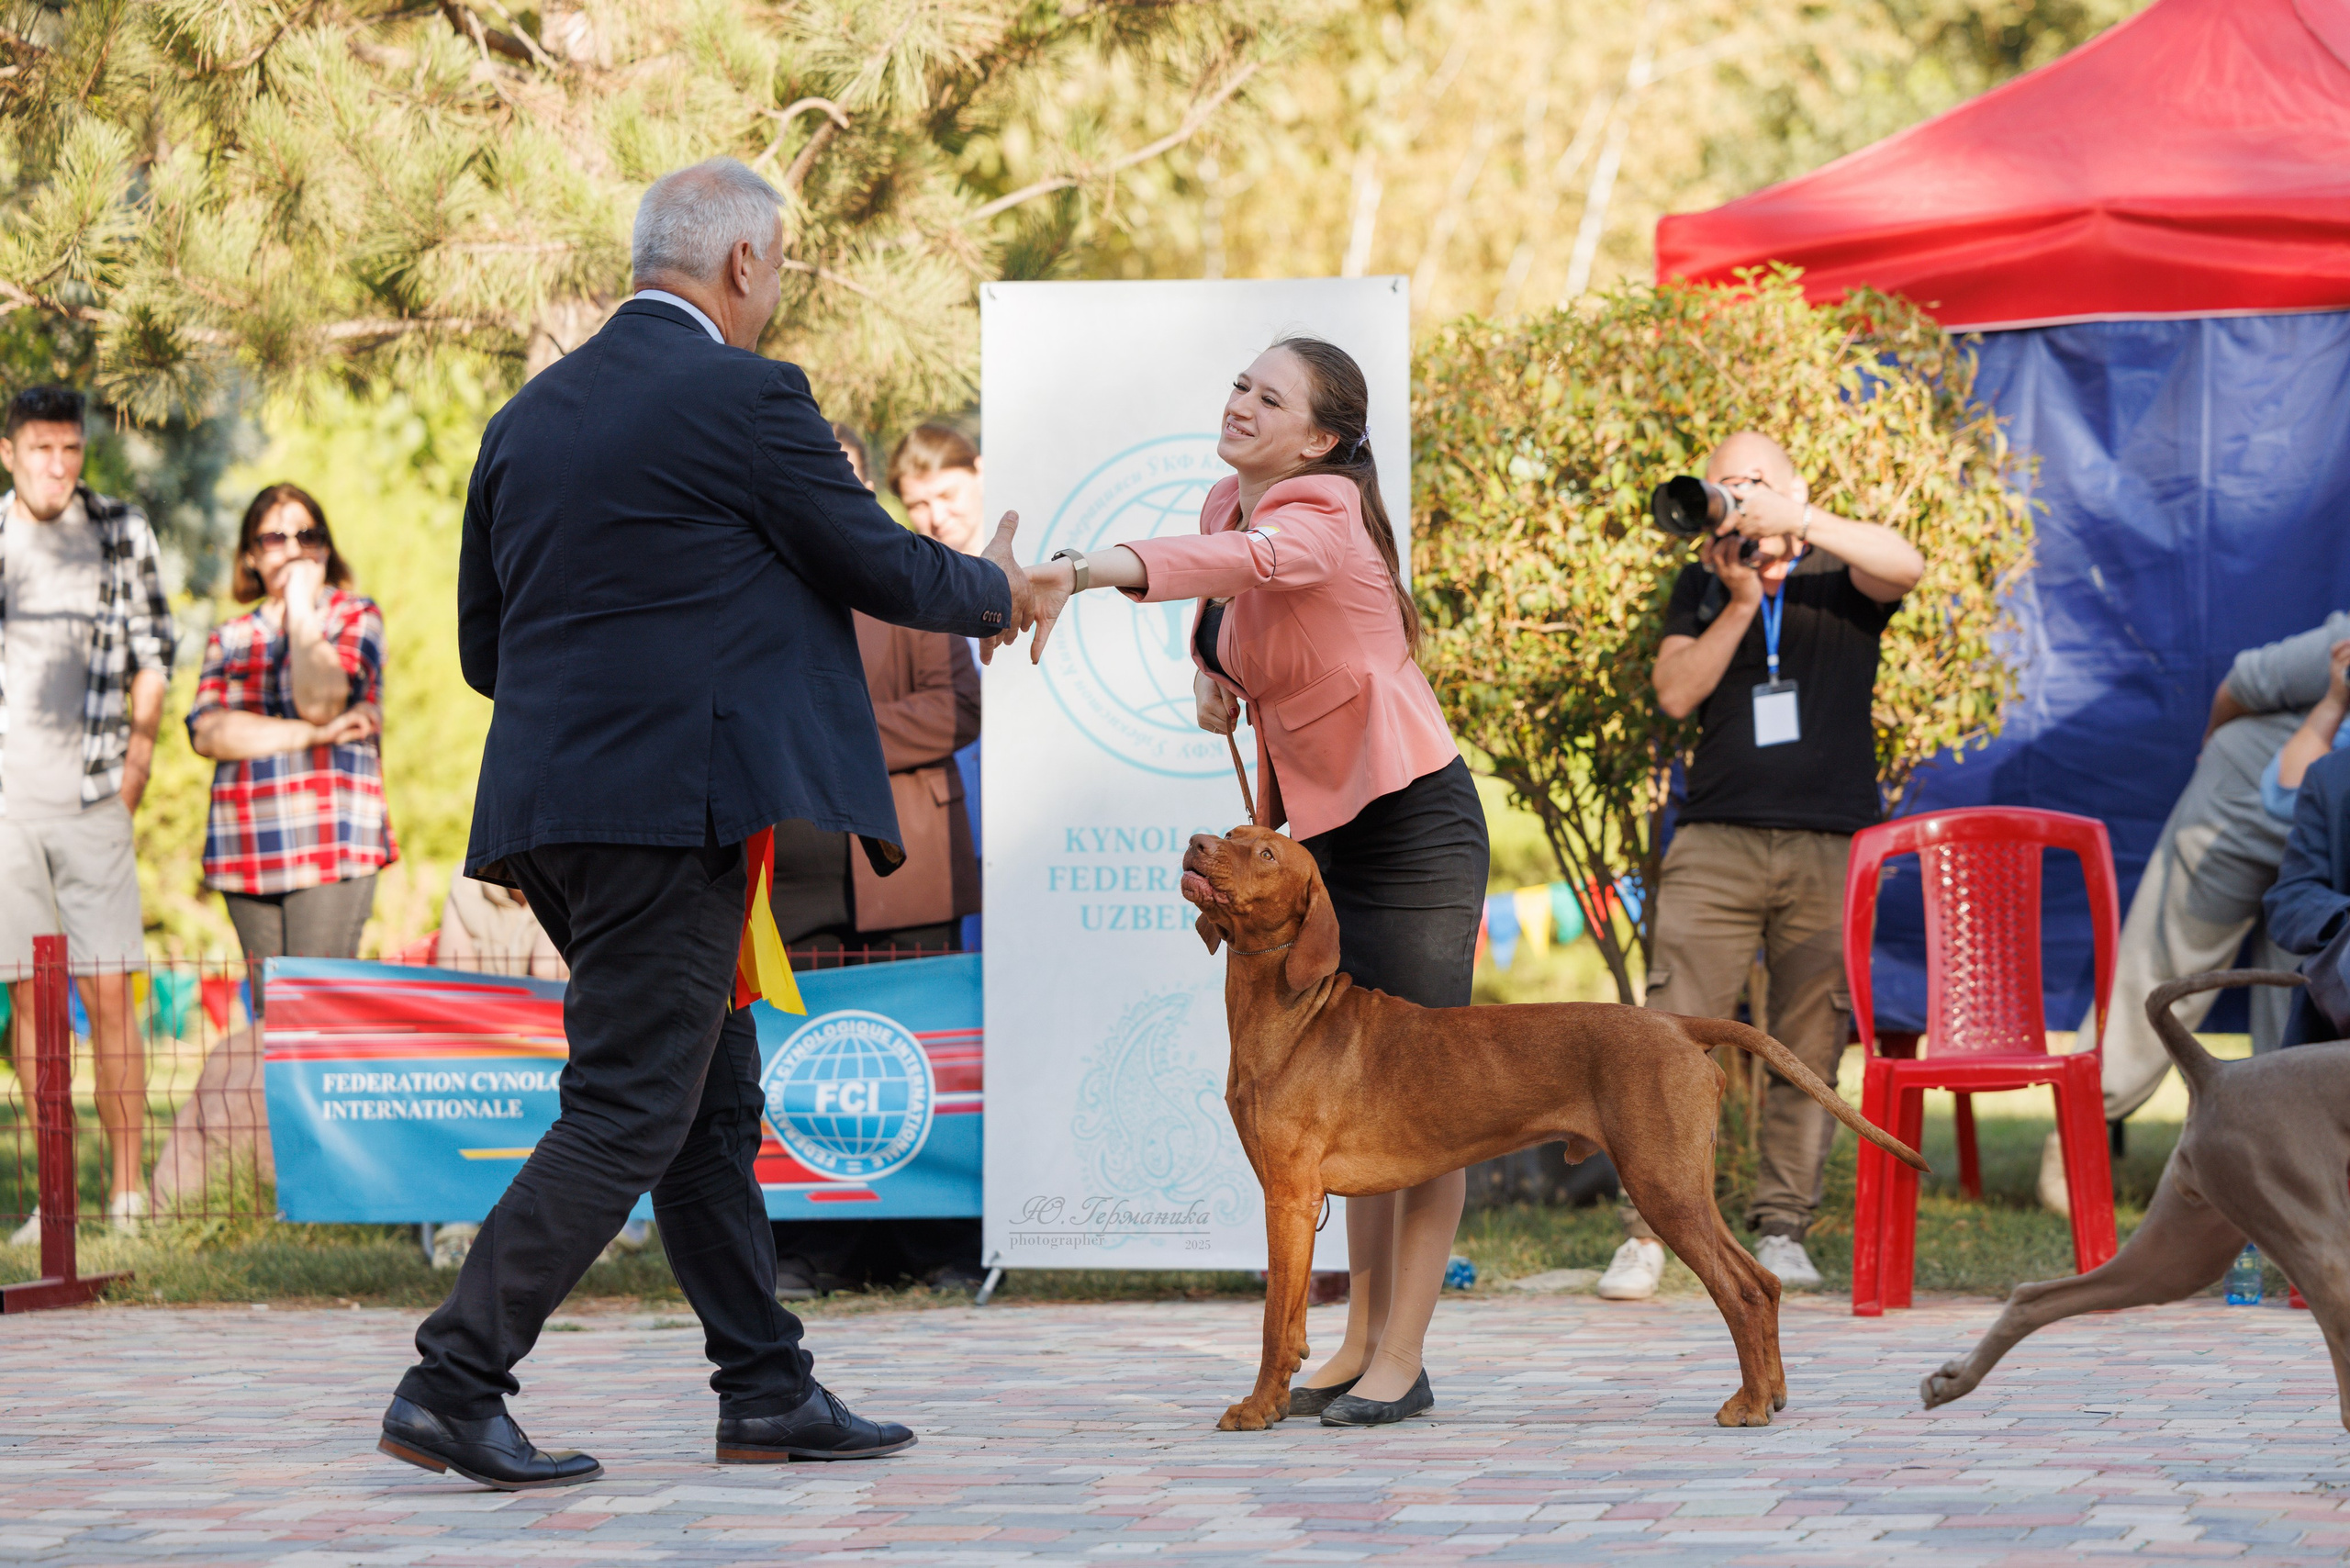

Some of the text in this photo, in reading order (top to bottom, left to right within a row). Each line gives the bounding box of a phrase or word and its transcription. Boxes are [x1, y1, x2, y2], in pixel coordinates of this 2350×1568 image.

[1065, 826, 1231, 853] KYNOL
[1080, 904, 1198, 931] UZBEK
[322, 1070, 562, 1093] FEDERATION CYNOLO
[322, 1099, 523, 1121] INTERNATIONALE
[815, 1080, 879, 1113] FCI
